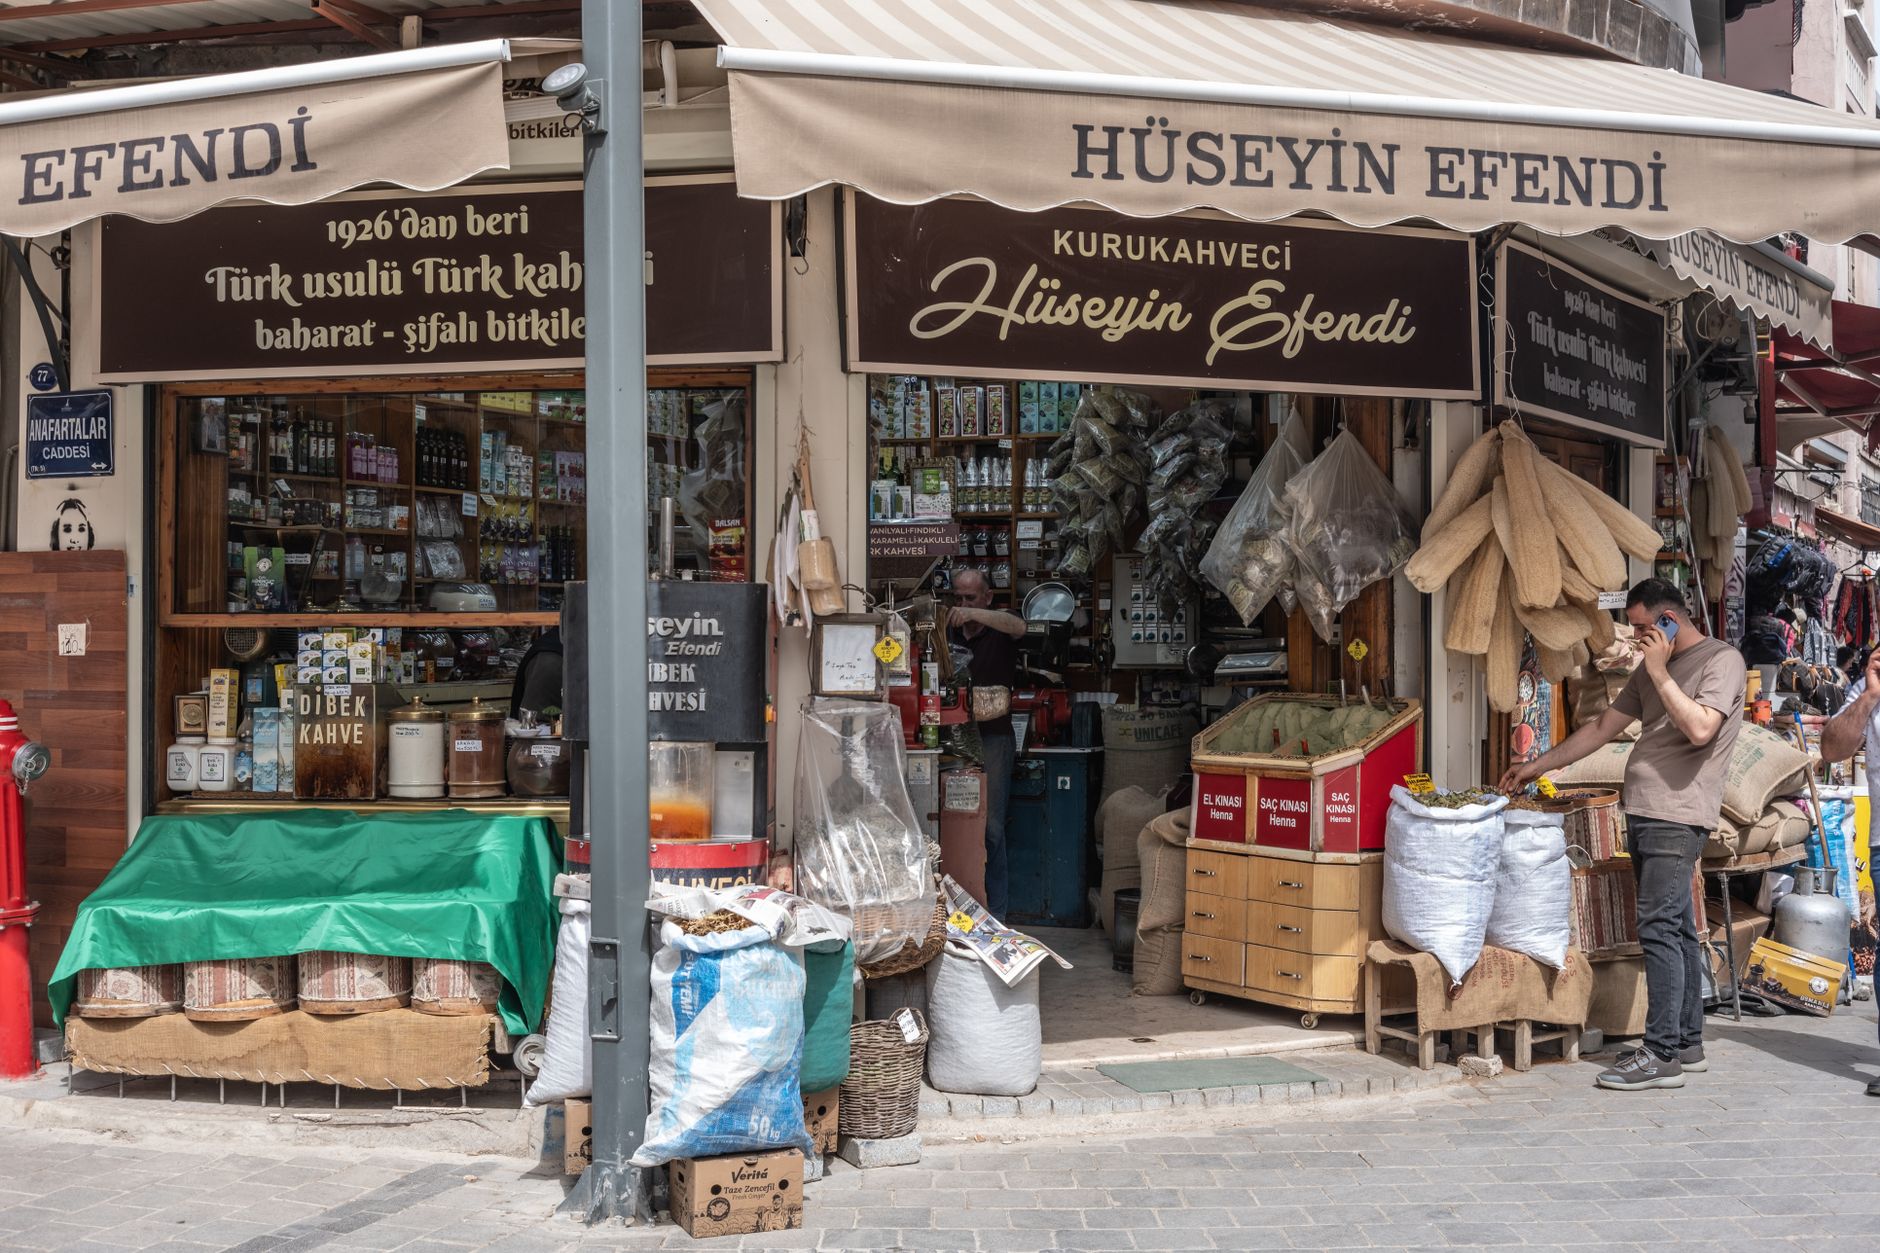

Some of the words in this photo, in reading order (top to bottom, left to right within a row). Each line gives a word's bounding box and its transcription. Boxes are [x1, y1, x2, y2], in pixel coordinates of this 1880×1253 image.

[508, 122, 580, 140] bitkiler
[18, 105, 318, 205] EFENDİ
[1070, 115, 1400, 196] HÜSEYİN
[1424, 145, 1669, 213] EFENDİ
[466, 204, 529, 237] beri
[1053, 228, 1291, 272] KURUKAHVECİ
[205, 264, 303, 306] Türk
[303, 259, 402, 299] usulü
[412, 253, 513, 299] Türk
[514, 250, 654, 295] kahi
[1744, 259, 1800, 319] EFENDİ
[909, 256, 1193, 342] Hüseyin
[1205, 279, 1417, 367] Efendi
[255, 318, 375, 352] baharat
[403, 309, 479, 353] şifalı
[486, 306, 586, 346] bitkile
[1527, 310, 1559, 357] Türk
[1558, 328, 1588, 361] usulü
[1589, 335, 1615, 378] Türk
[1612, 343, 1647, 384] kahvesi
[37, 370, 48, 382] 77
[1544, 362, 1581, 399] baharat
[29, 417, 107, 441] ANAFARTALAR
[43, 442, 90, 460] CADDESİ
[884, 545, 926, 555] KAHVESİ
[648, 612, 724, 639] seyin
[664, 641, 722, 656] Efendi
[648, 658, 696, 683] İBEK
[300, 685, 366, 717] DİBEK
[648, 688, 706, 712] HVESİ
[300, 723, 364, 745] KAHVE
[1203, 794, 1213, 805] EL
[1215, 795, 1242, 808] KINASI
[1260, 798, 1278, 811] SAÇ
[1280, 799, 1308, 813] KINASI
[1326, 804, 1355, 813] KINASI
[1331, 792, 1350, 803] SAÇ
[1210, 808, 1233, 821] Henna
[1269, 814, 1296, 828] Henna
[1330, 815, 1351, 823] Henna
[770, 1129, 780, 1141] kg
[723, 1186, 742, 1194] Taze
[744, 1183, 775, 1194] Zencefil
